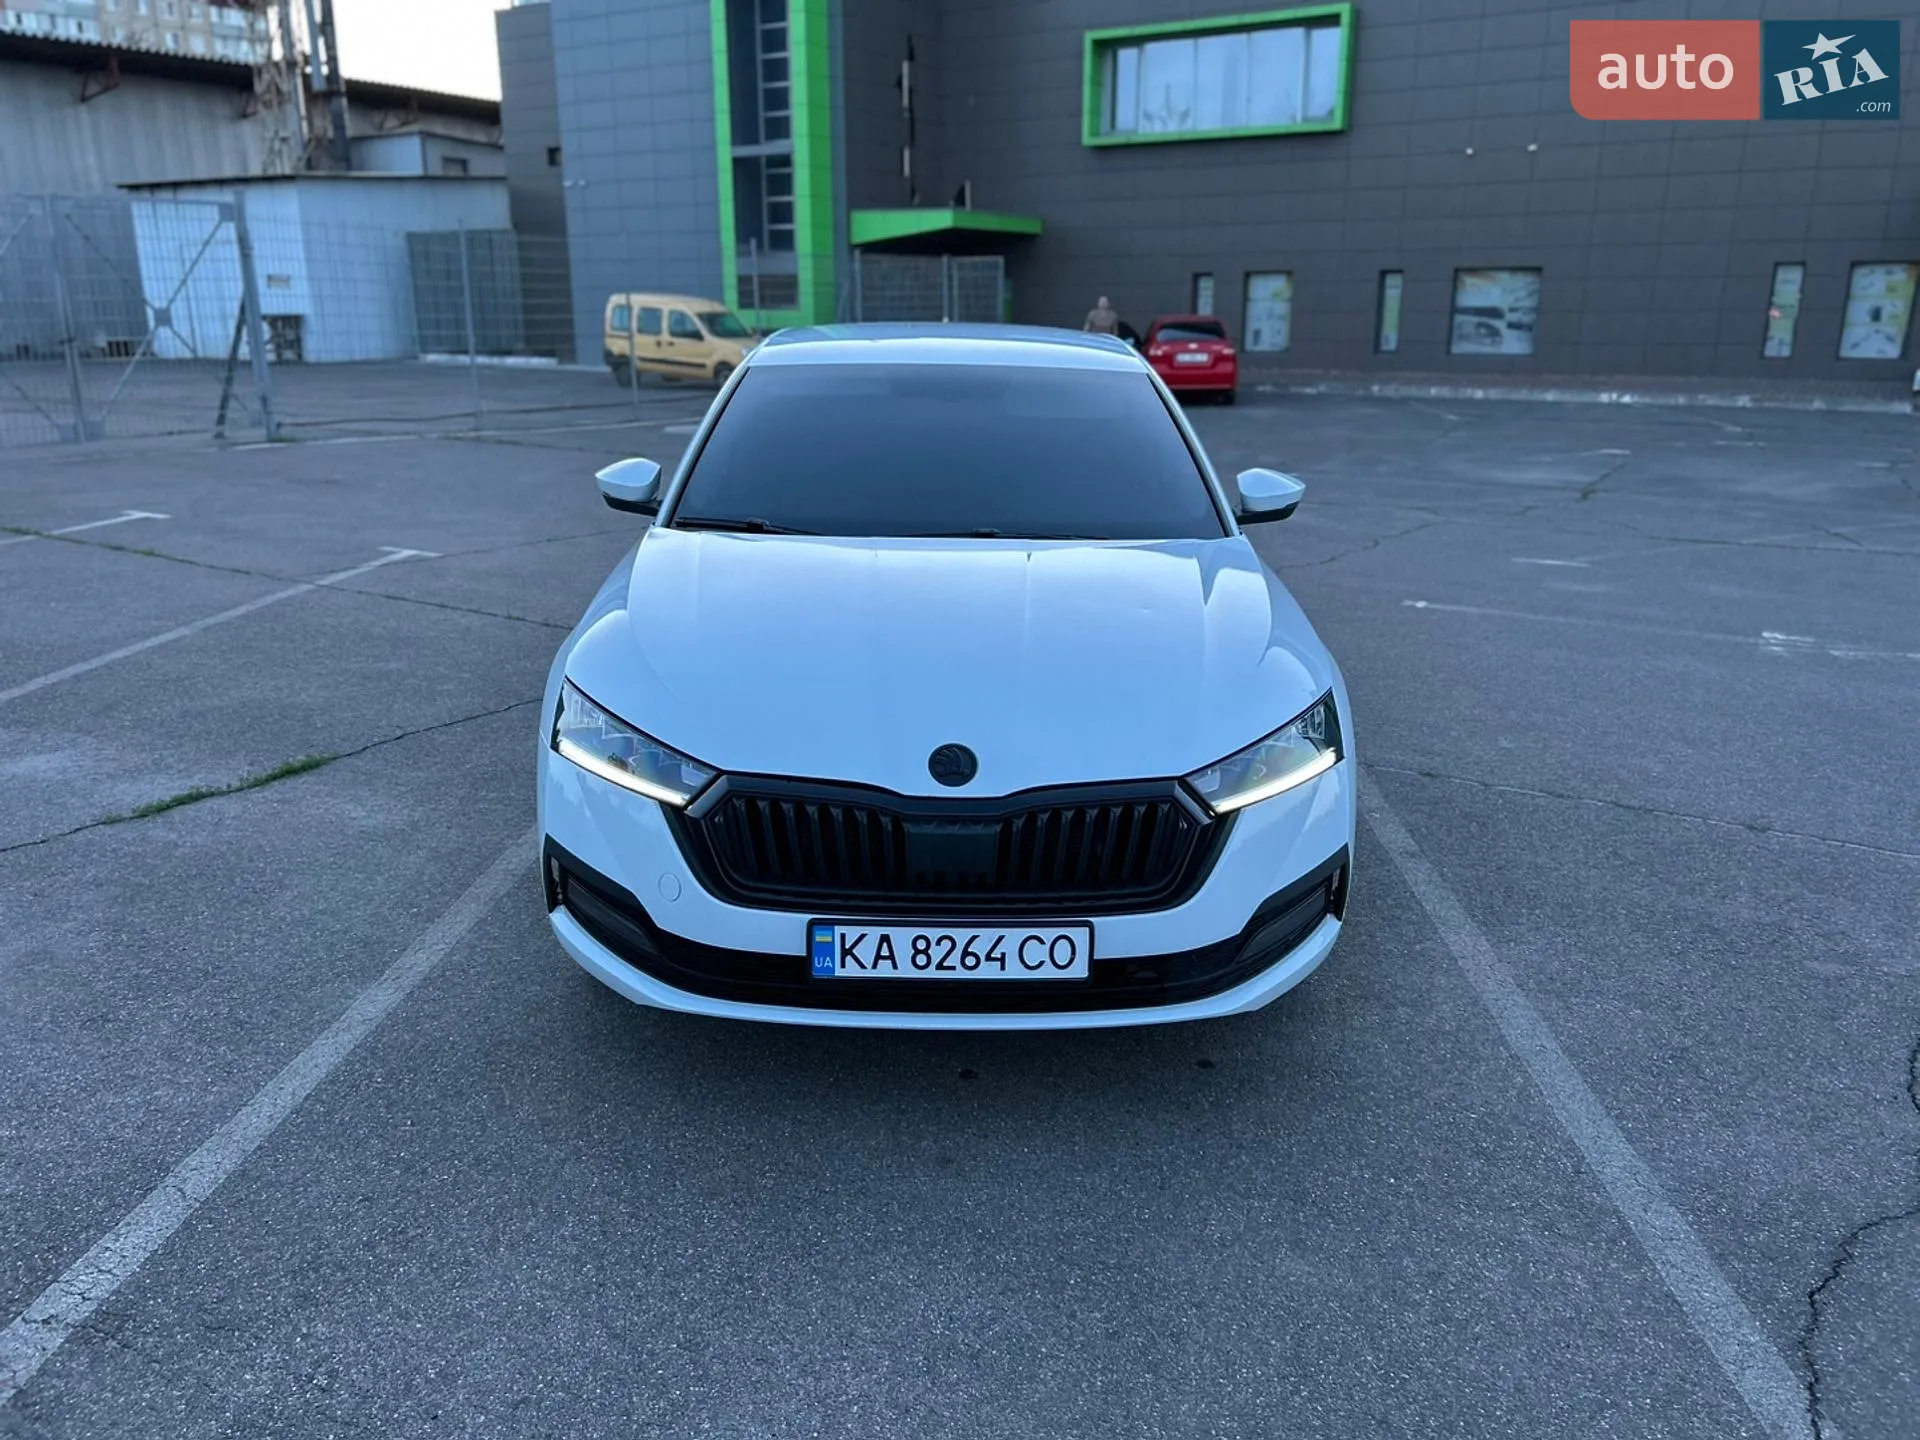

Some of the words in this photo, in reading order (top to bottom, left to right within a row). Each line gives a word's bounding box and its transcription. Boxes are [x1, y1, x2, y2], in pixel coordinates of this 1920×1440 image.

[814, 956, 833, 968] UA
[839, 932, 899, 970] KA
[910, 933, 1007, 971] 8264
[1017, 933, 1077, 971] CO
